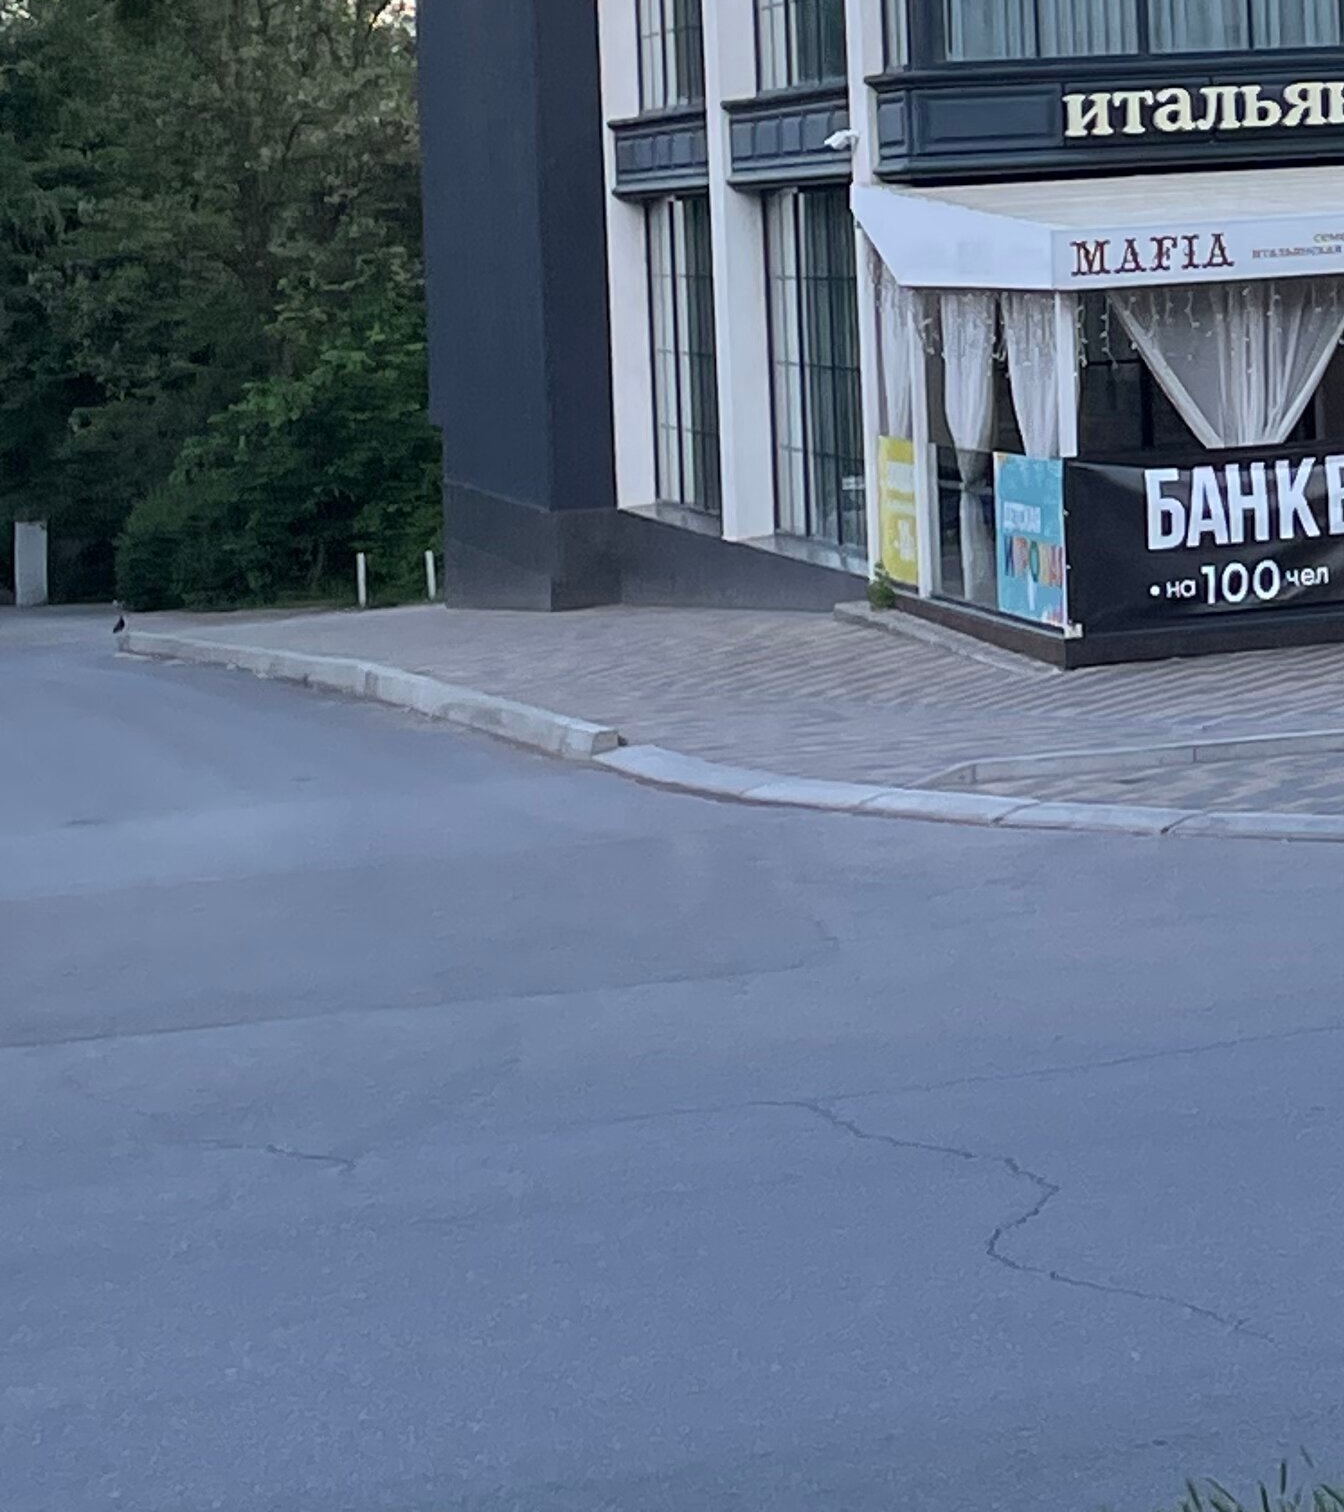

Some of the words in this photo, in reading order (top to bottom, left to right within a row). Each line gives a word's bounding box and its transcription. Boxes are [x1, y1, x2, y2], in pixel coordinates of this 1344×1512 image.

[1070, 233, 1235, 276] MAFIA
[1166, 580, 1196, 599] на
[1200, 559, 1281, 604] 100
[1285, 564, 1330, 586] чел
